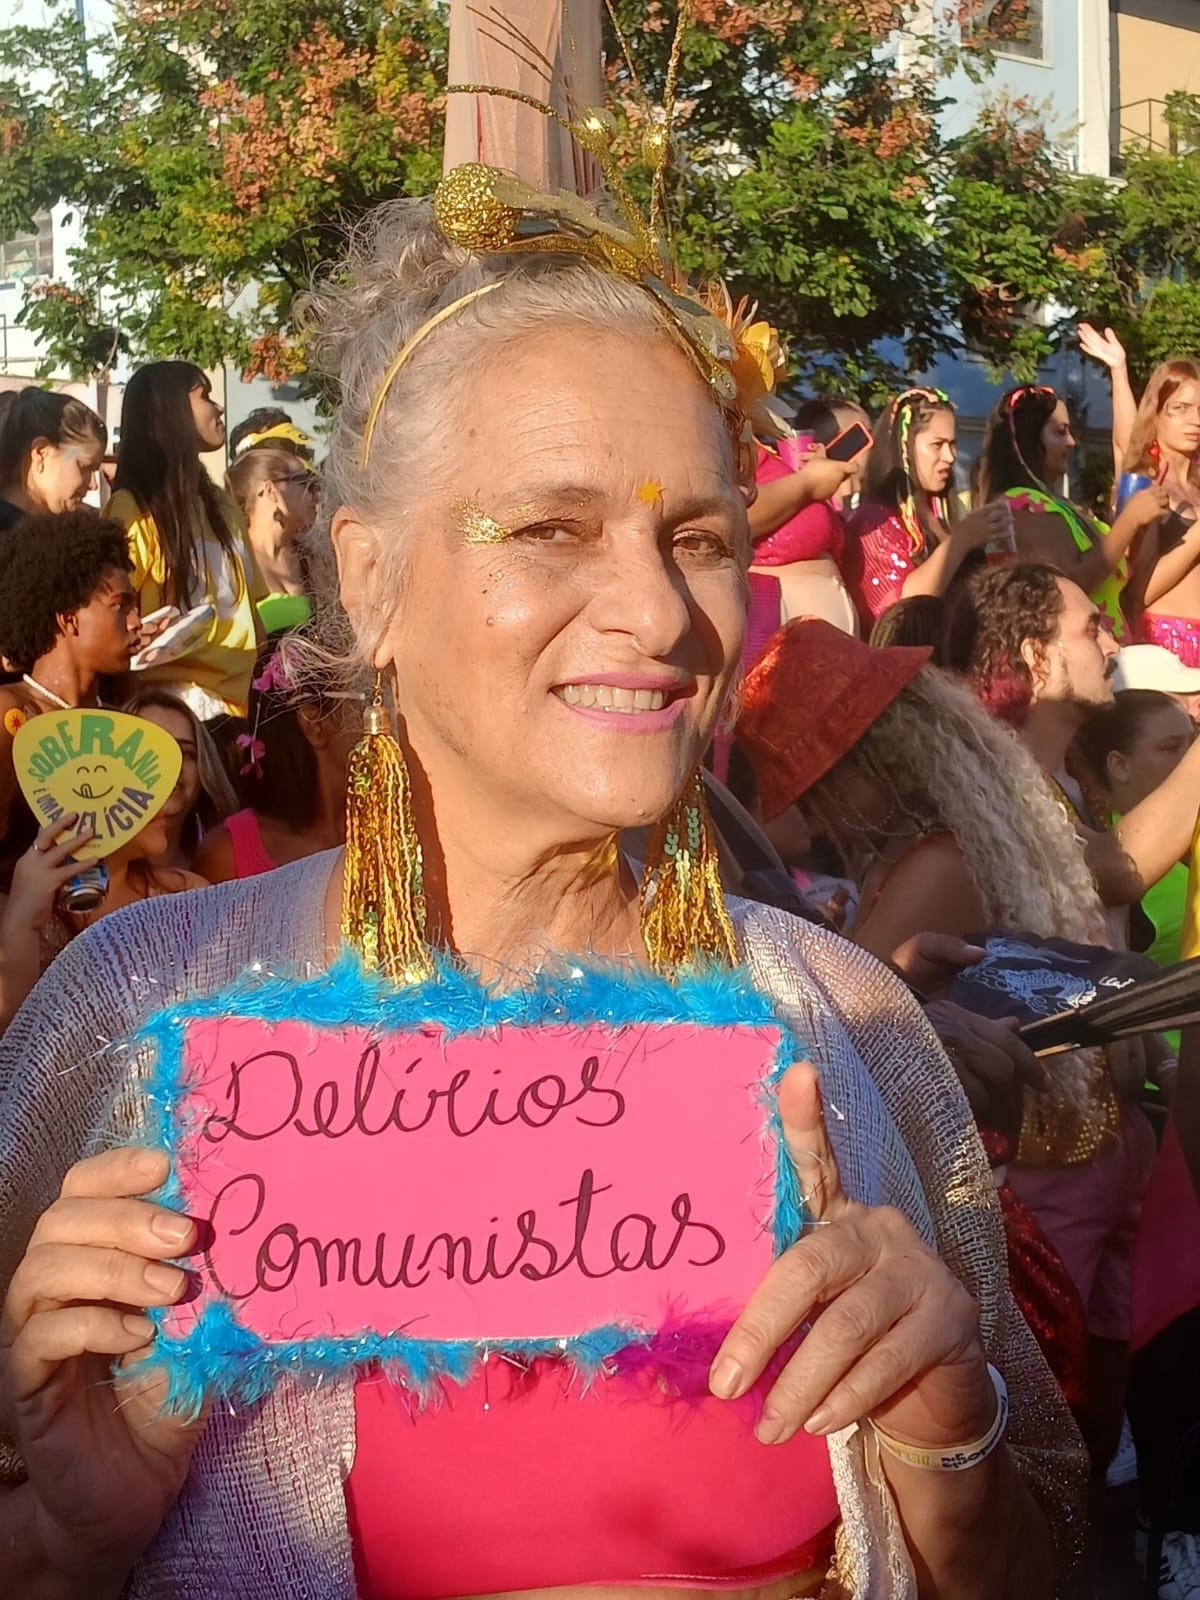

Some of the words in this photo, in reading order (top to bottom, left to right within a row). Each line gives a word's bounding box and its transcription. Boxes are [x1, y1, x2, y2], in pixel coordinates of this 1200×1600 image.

[64, 787, 154, 839] ELÍCIA
[203, 1043, 626, 1142] Delírios
[207, 1168, 726, 1299] Comunistas
